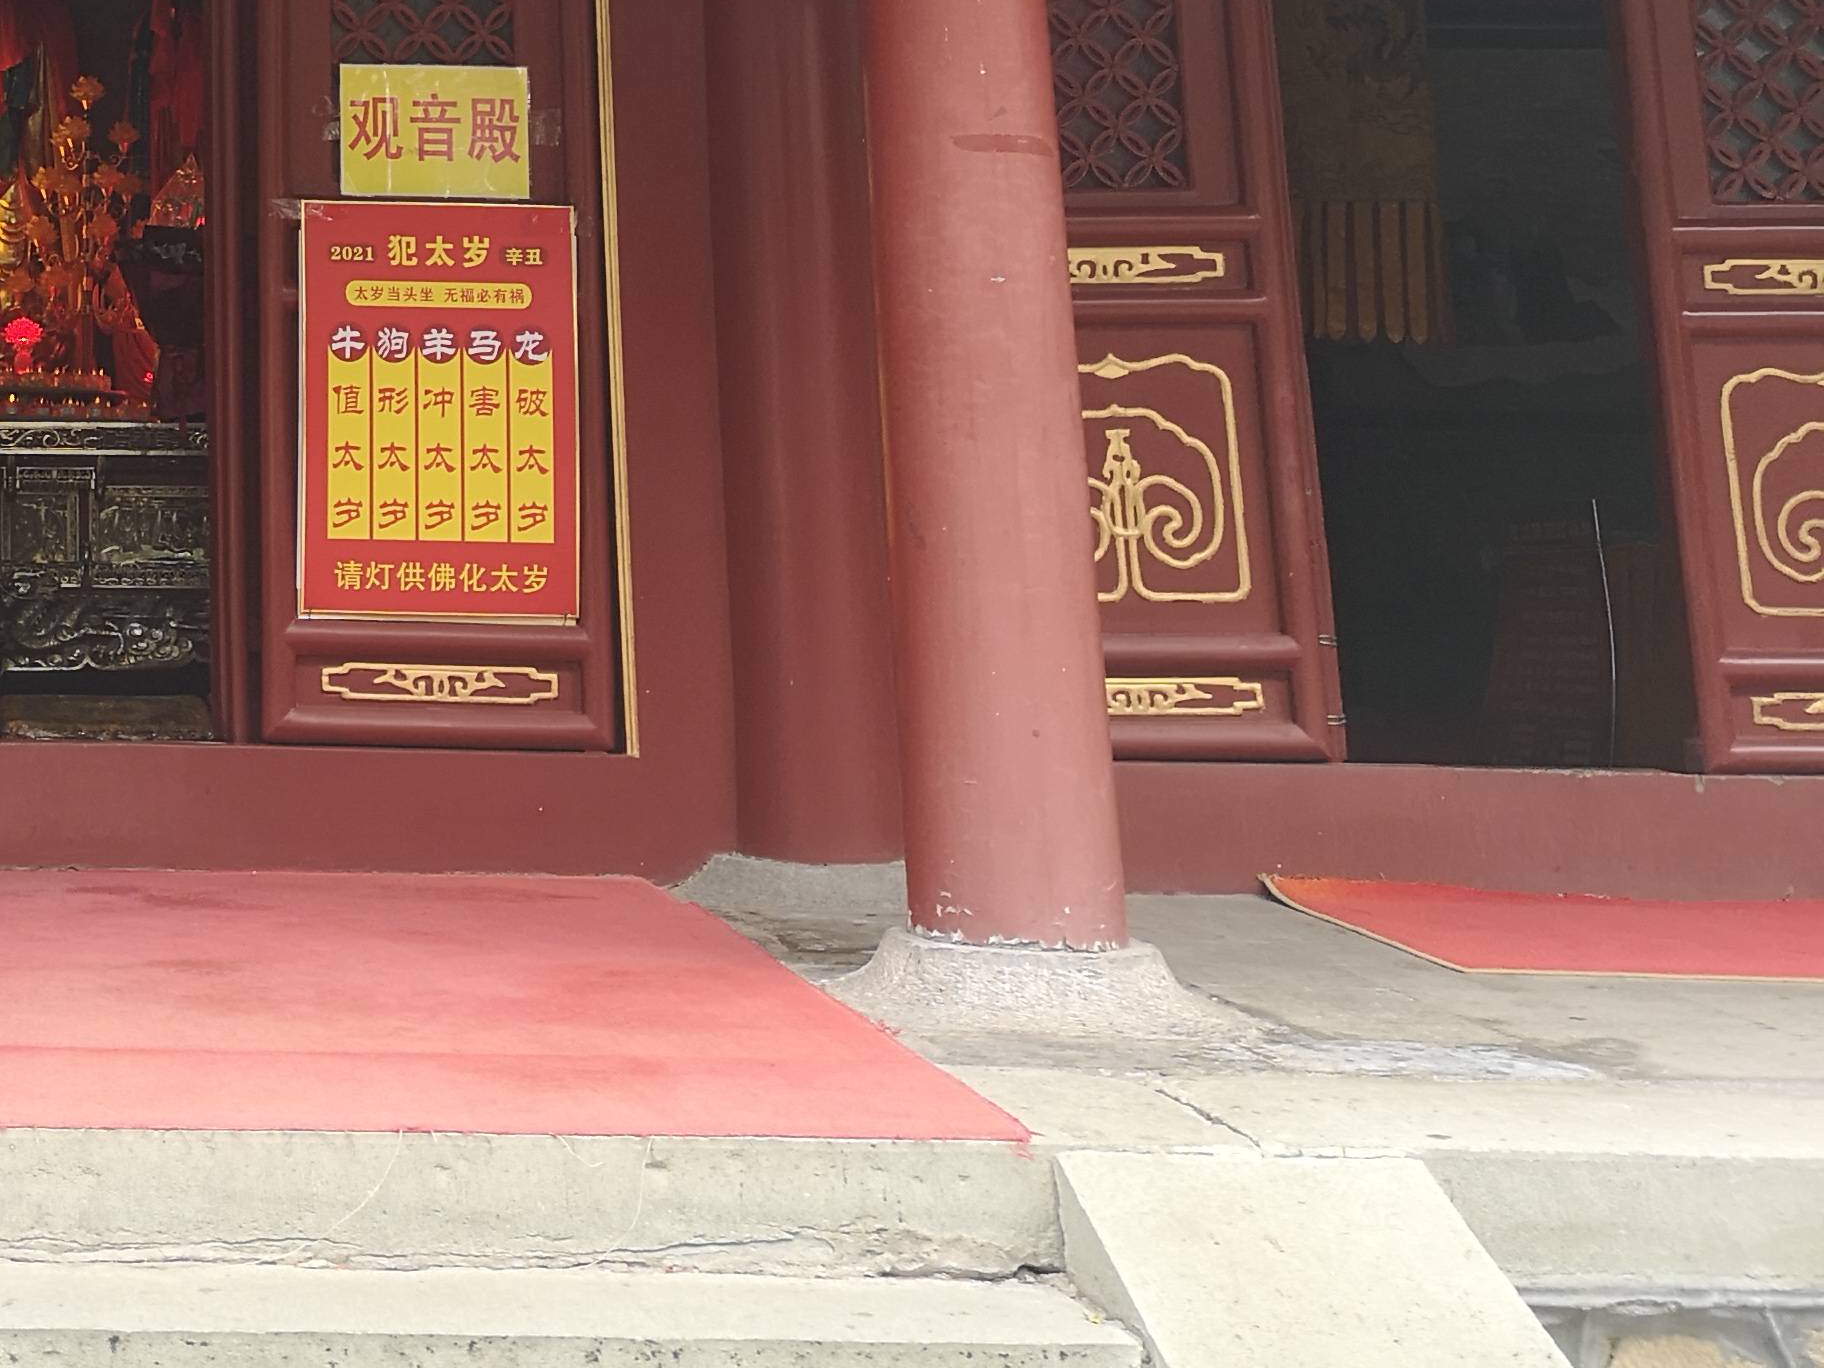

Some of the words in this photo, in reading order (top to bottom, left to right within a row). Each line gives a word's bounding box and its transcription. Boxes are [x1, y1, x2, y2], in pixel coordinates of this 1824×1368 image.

[348, 93, 522, 163] 观音殿
[330, 246, 374, 261] 2021
[387, 234, 490, 268] 犯太岁
[504, 248, 543, 266] 辛丑
[354, 285, 433, 302] 太岁当头坐
[444, 287, 525, 305] 无福必有祸
[334, 560, 548, 593] 请灯供佛化太岁
